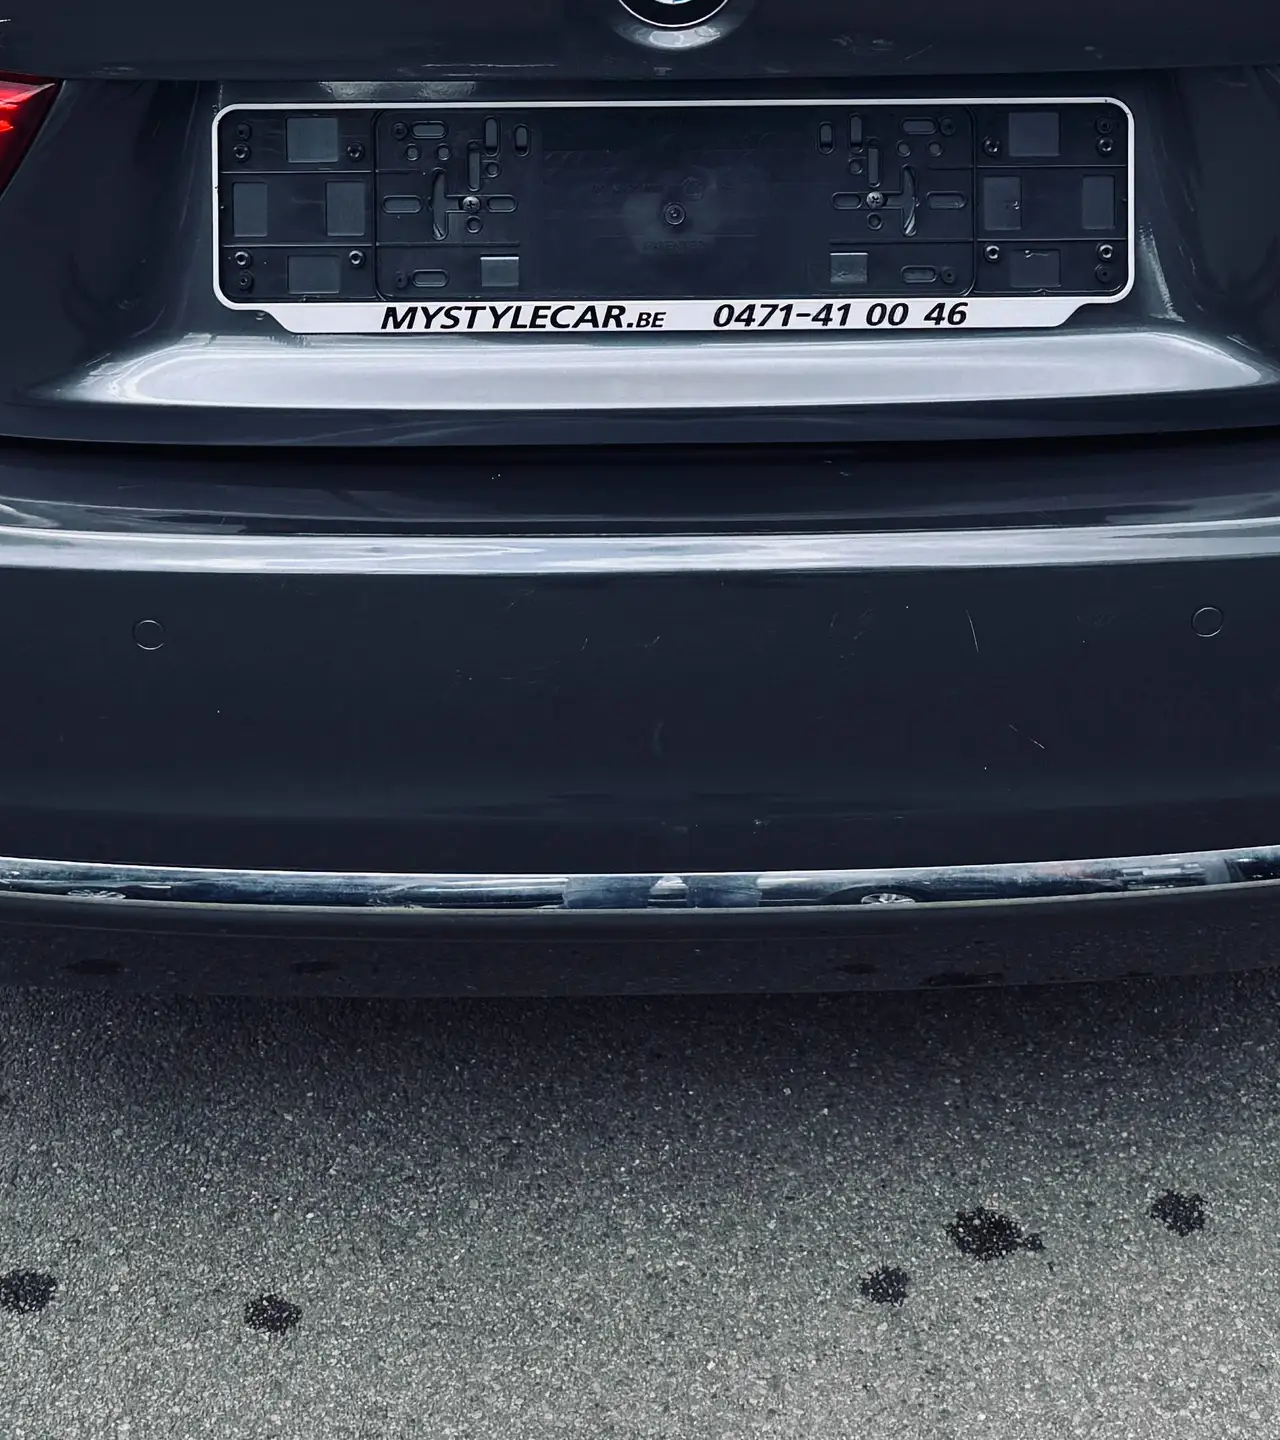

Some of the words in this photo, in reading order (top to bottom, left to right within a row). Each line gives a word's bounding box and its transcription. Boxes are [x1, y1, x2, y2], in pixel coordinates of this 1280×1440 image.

[381, 305, 666, 330] MYSTYLECAR.BE
[713, 303, 851, 327] 0471-41
[866, 302, 909, 326] 00
[923, 302, 969, 326] 46
